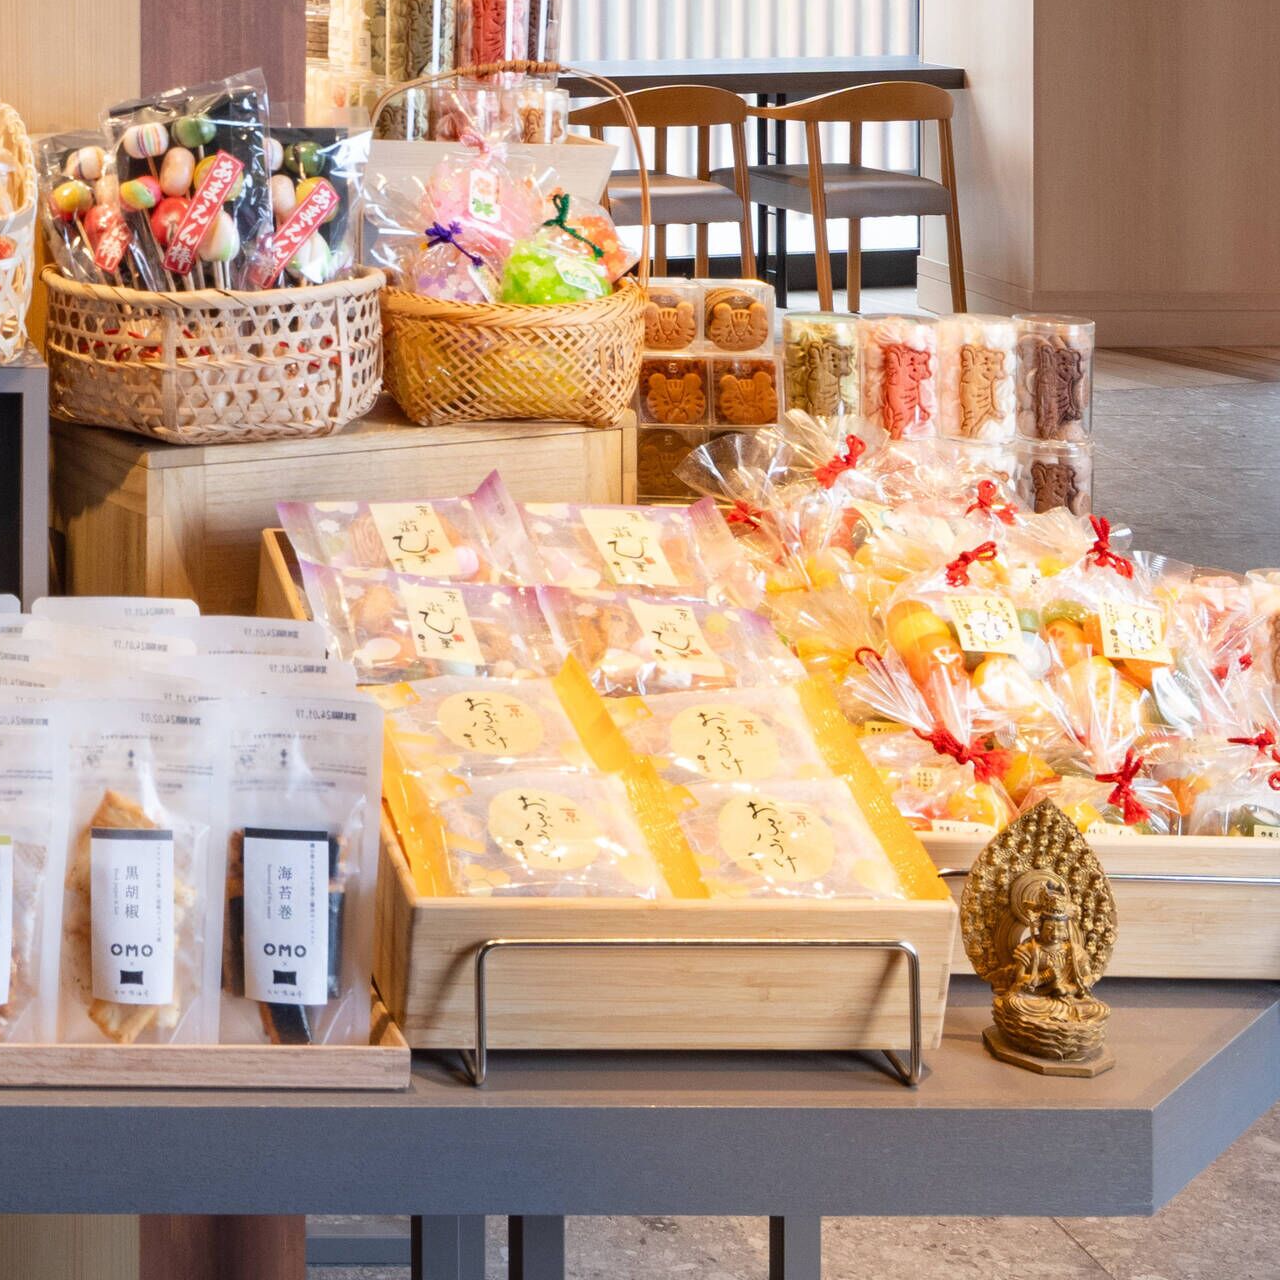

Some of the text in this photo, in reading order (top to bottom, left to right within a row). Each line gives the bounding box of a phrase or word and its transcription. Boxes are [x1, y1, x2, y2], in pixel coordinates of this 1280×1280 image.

[167, 158, 236, 271] あまえん棒
[125, 865, 140, 919] 黒胡椒
[278, 865, 293, 920] 海苔巻
[110, 943, 153, 957] OMO
[263, 942, 307, 958] OMO
